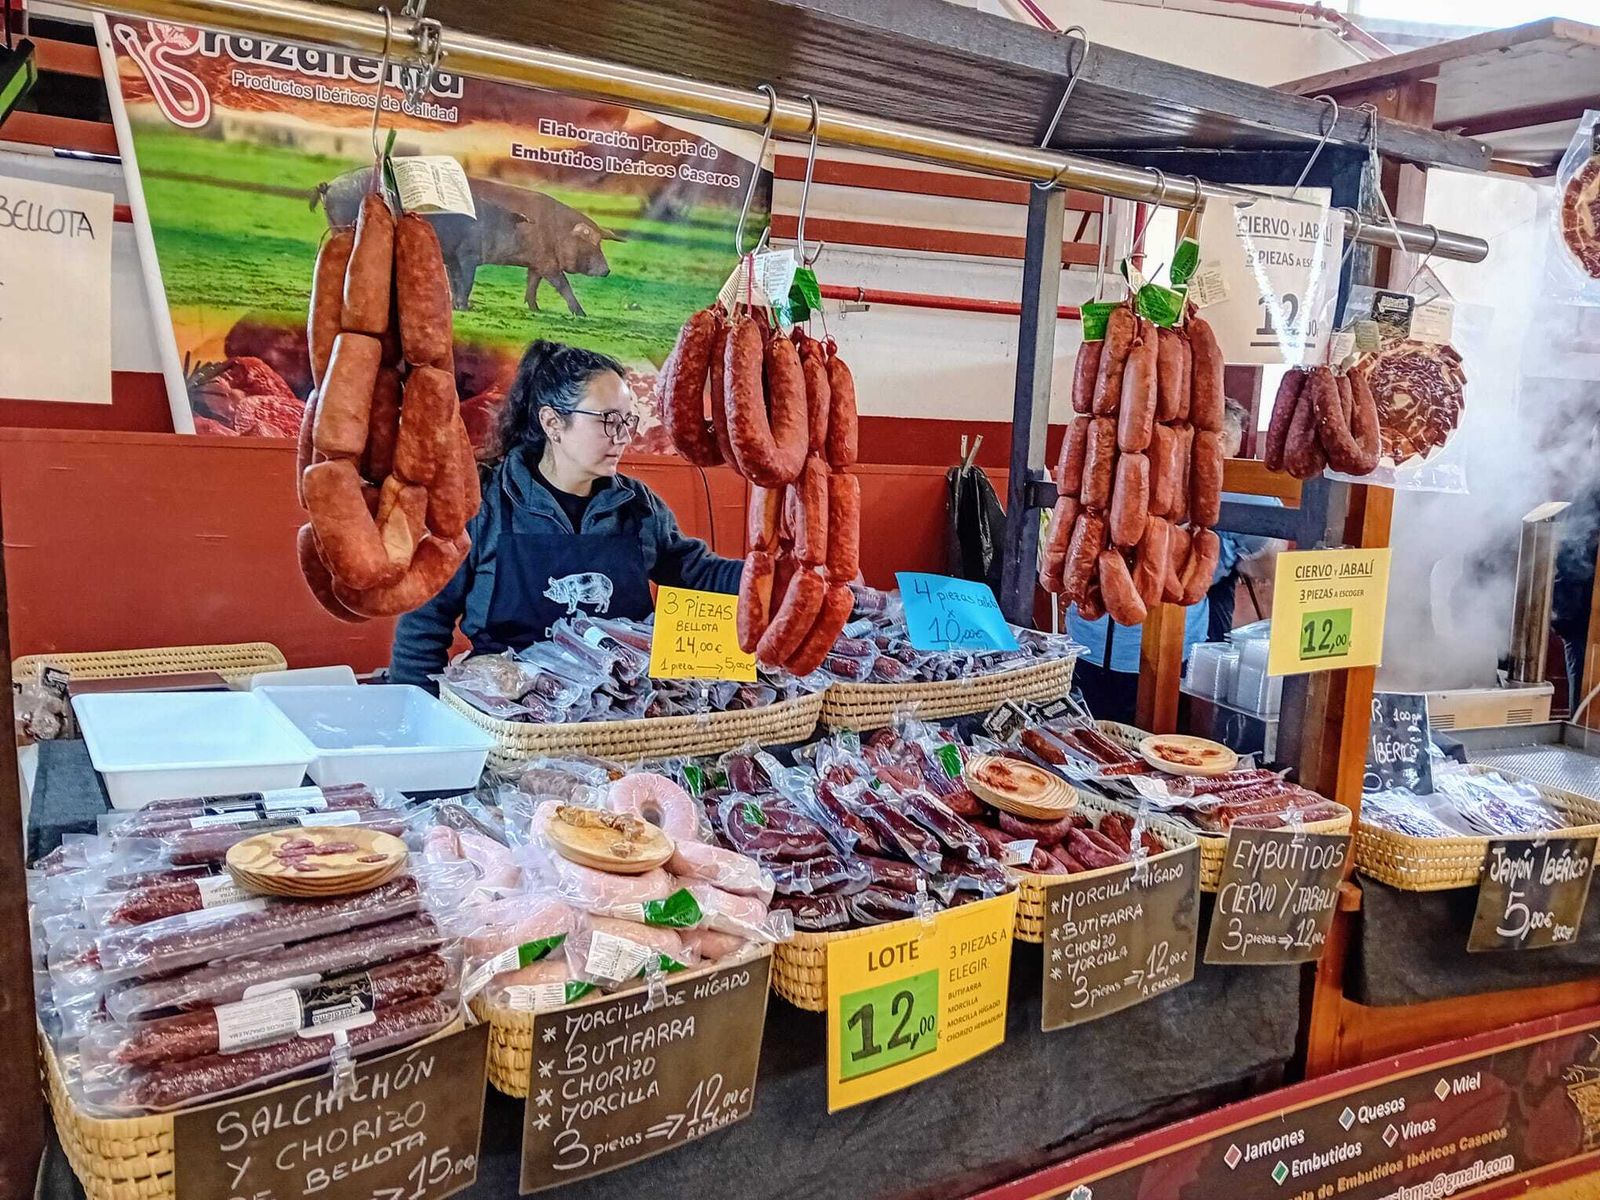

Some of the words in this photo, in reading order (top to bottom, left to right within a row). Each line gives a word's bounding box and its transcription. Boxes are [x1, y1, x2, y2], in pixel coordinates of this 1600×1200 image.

[232, 70, 313, 98] Productos
[316, 84, 378, 107] Ibéricos
[381, 95, 399, 111] de
[402, 101, 458, 122] Calidad
[539, 118, 639, 150] Elaboración
[642, 135, 697, 157] Propia
[699, 142, 718, 160] de
[510, 143, 603, 171] Embutidos
[606, 156, 676, 178] Ibéricos
[679, 163, 741, 187] Caseros
[0, 195, 95, 240] BELLOTA
[1258, 250, 1294, 267] PIEZAS
[1295, 563, 1333, 579] CIERVO
[1339, 559, 1375, 576] JABALÍ
[664, 592, 679, 615] 3
[685, 595, 733, 621] PIEZAS
[914, 579, 932, 604] 4
[937, 591, 976, 611] piezas
[1299, 589, 1306, 601] 3
[1307, 588, 1334, 600] PIEZAS
[1339, 589, 1365, 598] ESCOGER
[676, 620, 719, 633] BELLOTA
[660, 658, 667, 671] 1
[1233, 838, 1346, 878] EMBUTIDOS
[1061, 877, 1130, 921] MORCILLA
[1141, 863, 1184, 888] HÍGADO
[1219, 878, 1277, 914] CIERVO
[1279, 877, 1298, 919] Y
[1062, 904, 1144, 940] BUTIFARRA
[1222, 917, 1243, 951] 3
[1244, 926, 1277, 957] piezas
[868, 939, 920, 972] LOTE
[949, 945, 957, 960] 3
[960, 931, 998, 957] PIEZAS
[999, 928, 1008, 942] A
[1065, 933, 1116, 959] CHORIZO
[1067, 945, 1128, 982] MORCILLA
[947, 981, 982, 1000] BUTIFARRA
[947, 996, 978, 1014] MORCILLA
[1070, 975, 1090, 1009] 3
[565, 1001, 656, 1053] MORCILLA
[665, 990, 687, 1007] DE
[694, 970, 751, 1000] HÍGADO
[947, 1010, 978, 1029] MORCILLA
[559, 1014, 697, 1074] BUTIFARRA
[946, 1025, 974, 1042] CHORIZO
[562, 1056, 657, 1101] CHORIZO
[216, 1049, 435, 1151] SALCHICHÓN
[561, 1079, 660, 1130] MORCILLA
[1242, 1127, 1305, 1163] Jamones
[1357, 1096, 1406, 1124] Quesos
[1452, 1072, 1481, 1096] Miel
[226, 1156, 251, 1190] Y
[276, 1101, 427, 1171] CHORIZO
[302, 1130, 428, 1196] BELLOTA
[552, 1128, 590, 1171] 3
[593, 1132, 643, 1165] piezas
[1291, 1140, 1363, 1178] Embutidos
[1400, 1116, 1437, 1141] Vinos
[1317, 1183, 1335, 1200] de
[1337, 1159, 1404, 1193] Embutidos
[1406, 1143, 1457, 1169] Ibéricos
[1459, 1127, 1508, 1151] Caseros
